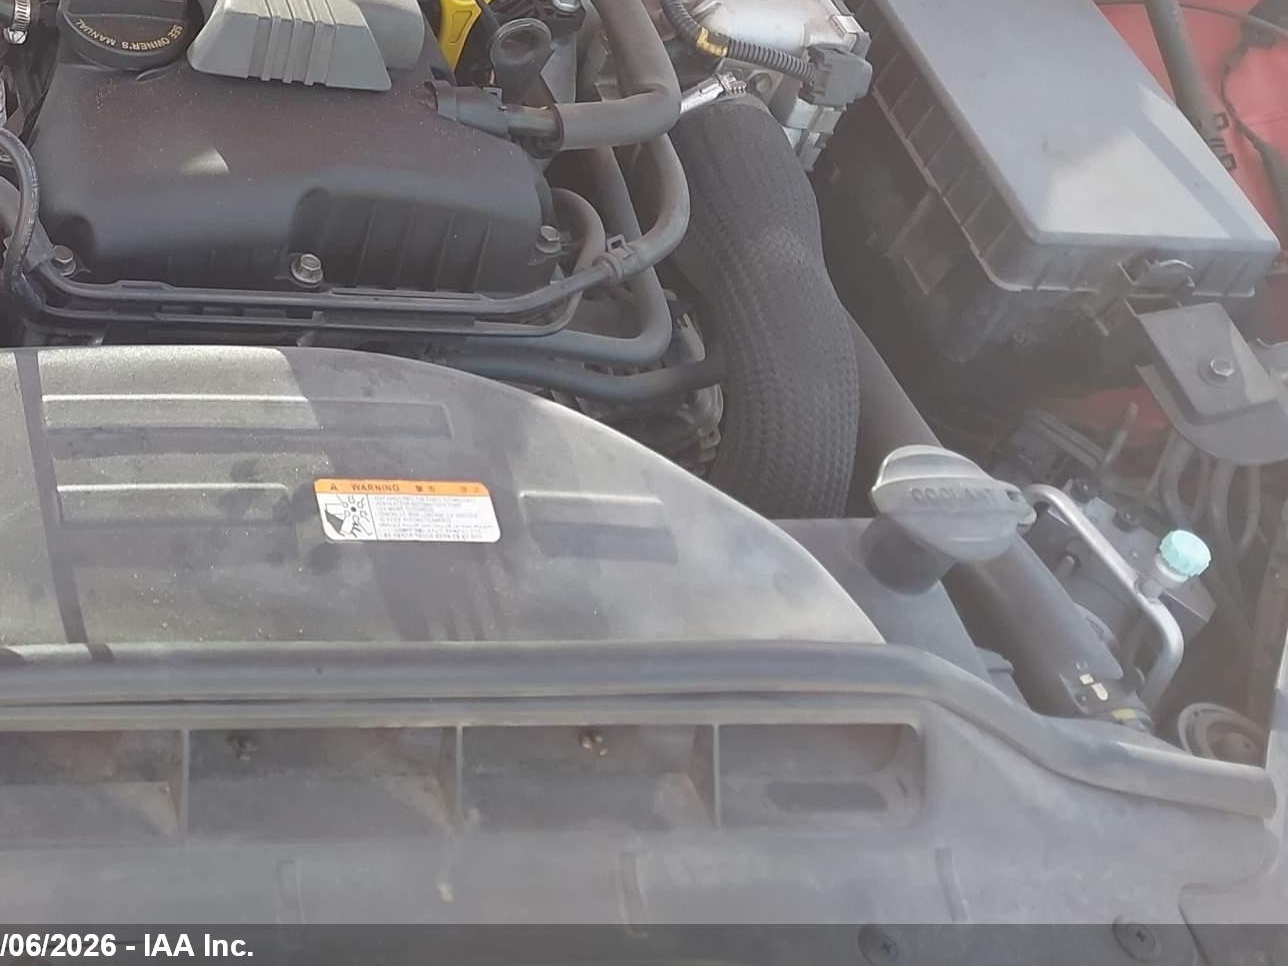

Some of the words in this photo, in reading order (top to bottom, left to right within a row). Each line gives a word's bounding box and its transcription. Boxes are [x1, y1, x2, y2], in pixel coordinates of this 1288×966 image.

[75, 18, 117, 46] MANUAL
[168, 24, 184, 40] SEE
[120, 37, 171, 51] OWNER'S
[351, 483, 401, 493] WARNING
